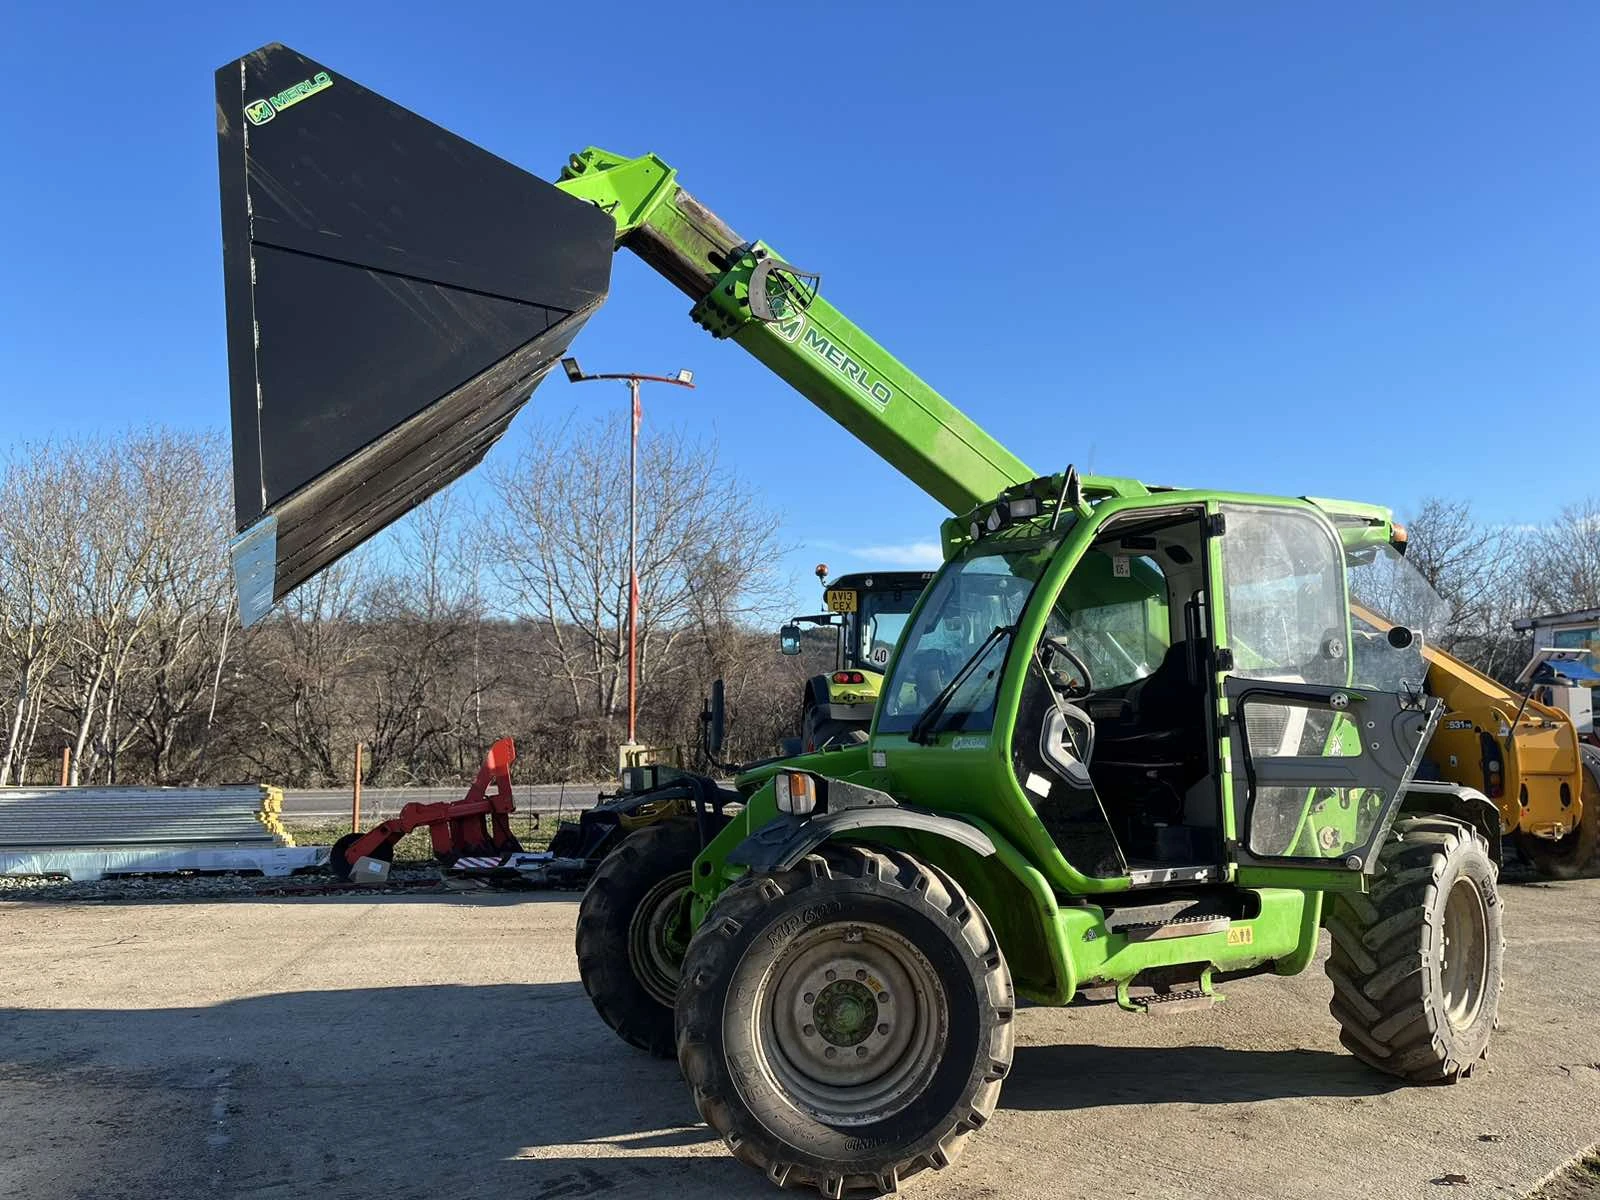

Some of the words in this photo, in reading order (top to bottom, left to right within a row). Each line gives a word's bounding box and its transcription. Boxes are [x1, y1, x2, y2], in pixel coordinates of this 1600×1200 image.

[269, 71, 331, 109] MERLO
[803, 327, 893, 404] MERLO
[832, 592, 852, 601] AV13
[833, 602, 851, 611] CEX
[874, 649, 887, 663] 40
